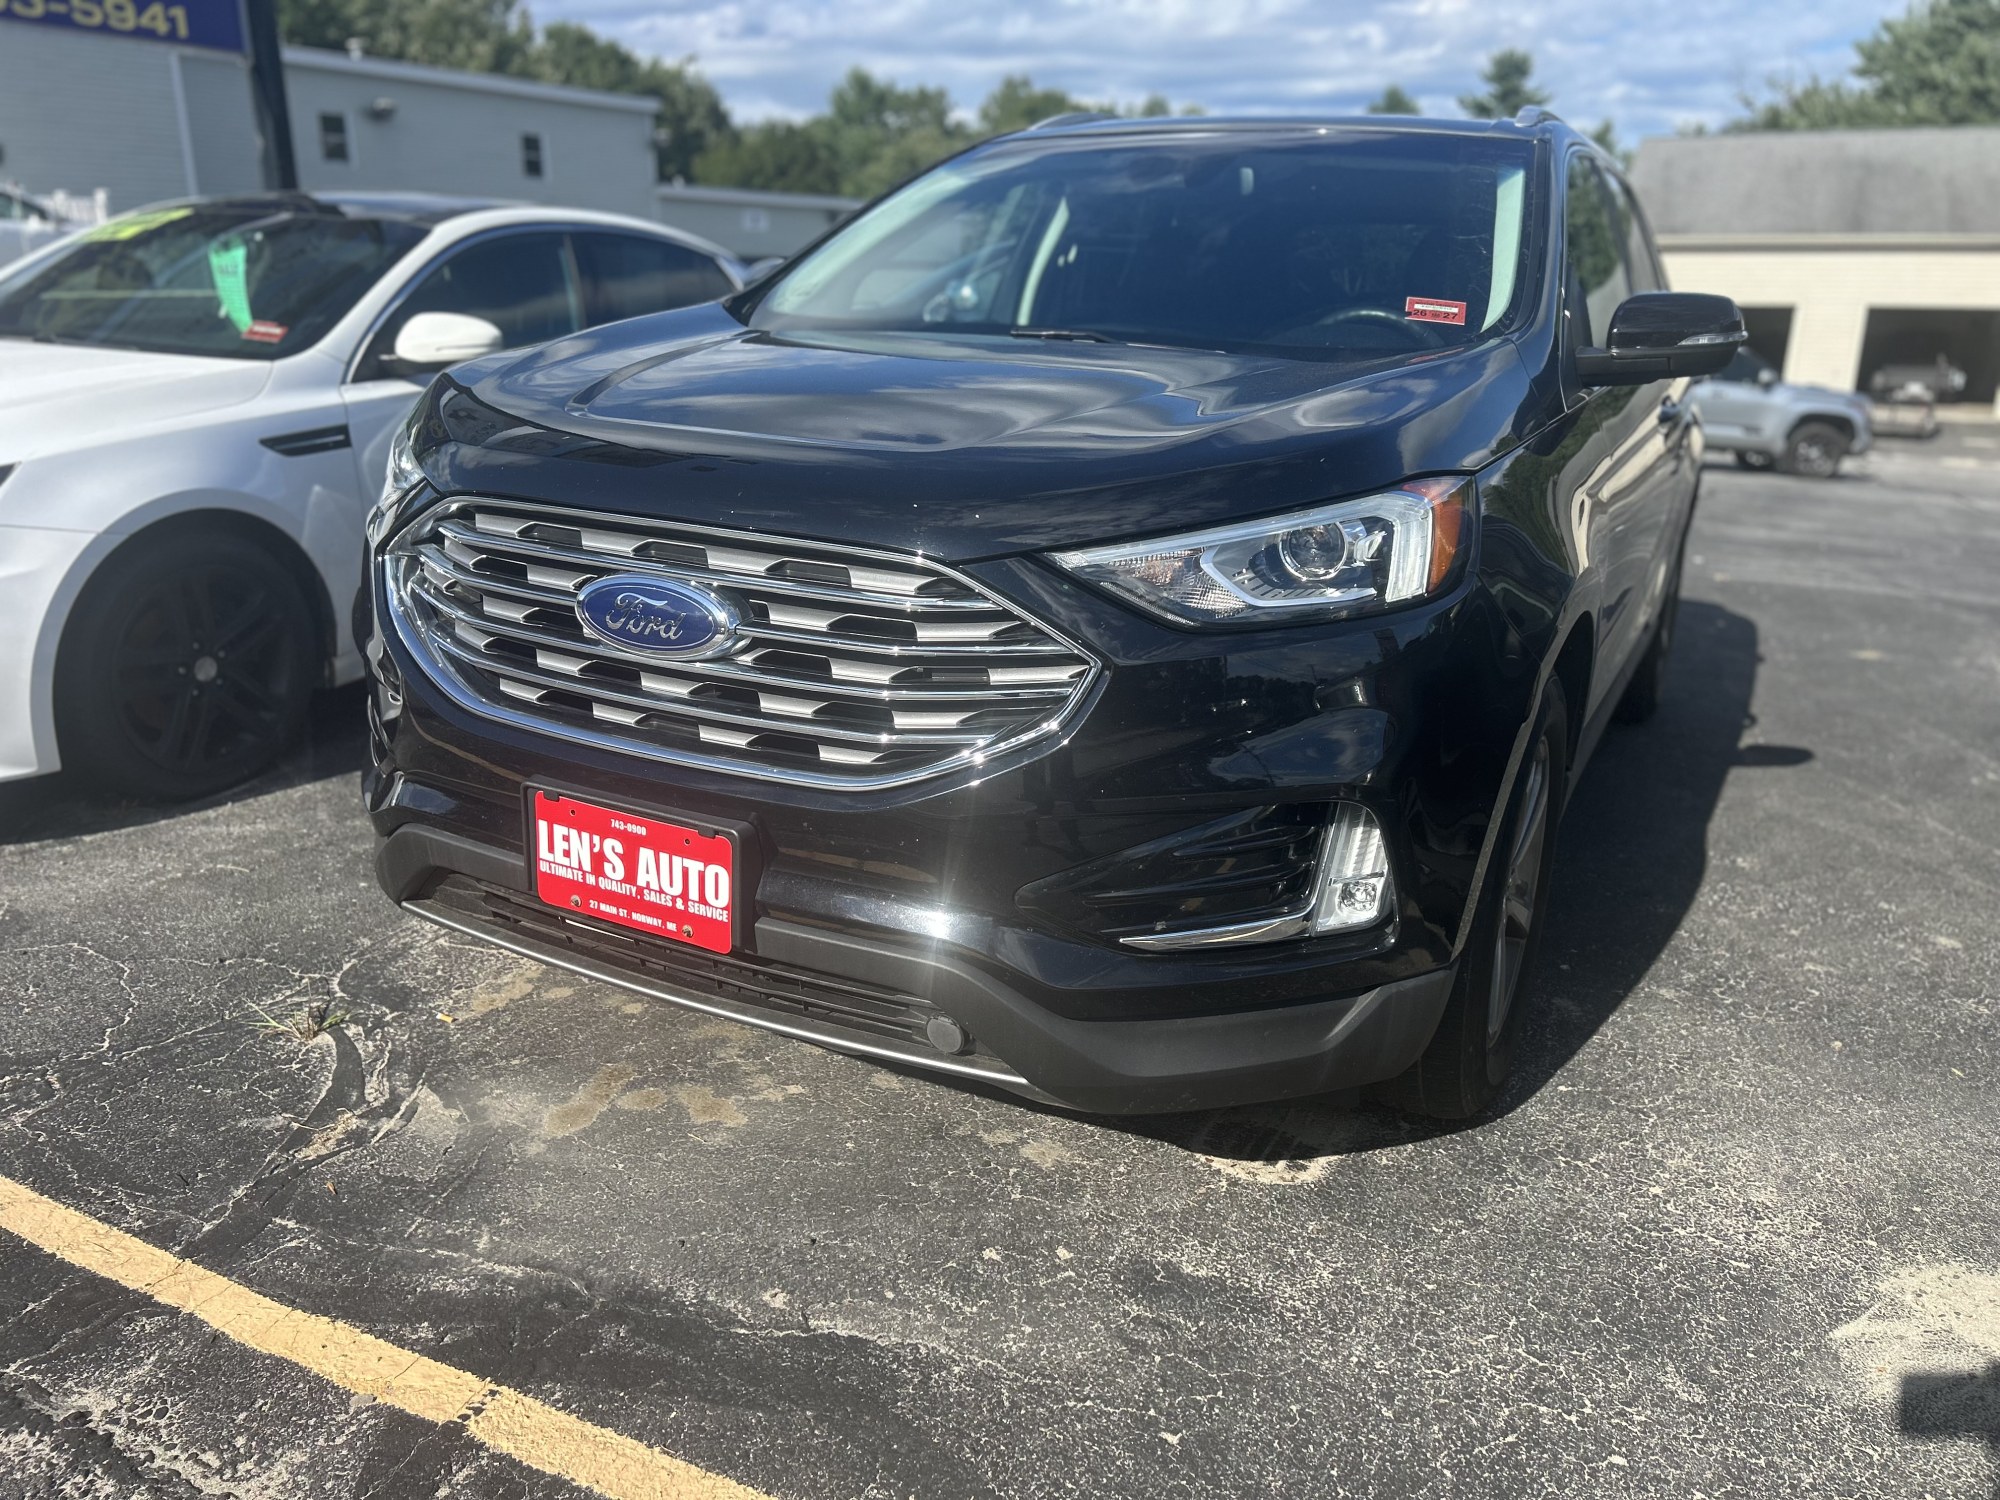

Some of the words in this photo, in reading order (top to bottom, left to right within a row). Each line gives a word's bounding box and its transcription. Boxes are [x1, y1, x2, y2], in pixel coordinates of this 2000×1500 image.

[0, 0, 189, 39] 3-5941
[605, 592, 687, 640] Ford
[610, 818, 647, 836] 743-0900
[537, 819, 625, 881] LEN'S
[636, 847, 730, 908] AUTO
[539, 860, 583, 883] ULTIMATE
[586, 873, 596, 886] IN
[598, 875, 640, 900] QUALITY,
[643, 888, 672, 907] SALES
[675, 896, 685, 911] &
[687, 901, 729, 922] SERVICE
[589, 899, 598, 910] 27
[599, 902, 618, 914] MAIN
[619, 906, 630, 919] ST.
[666, 922, 677, 932] ME
